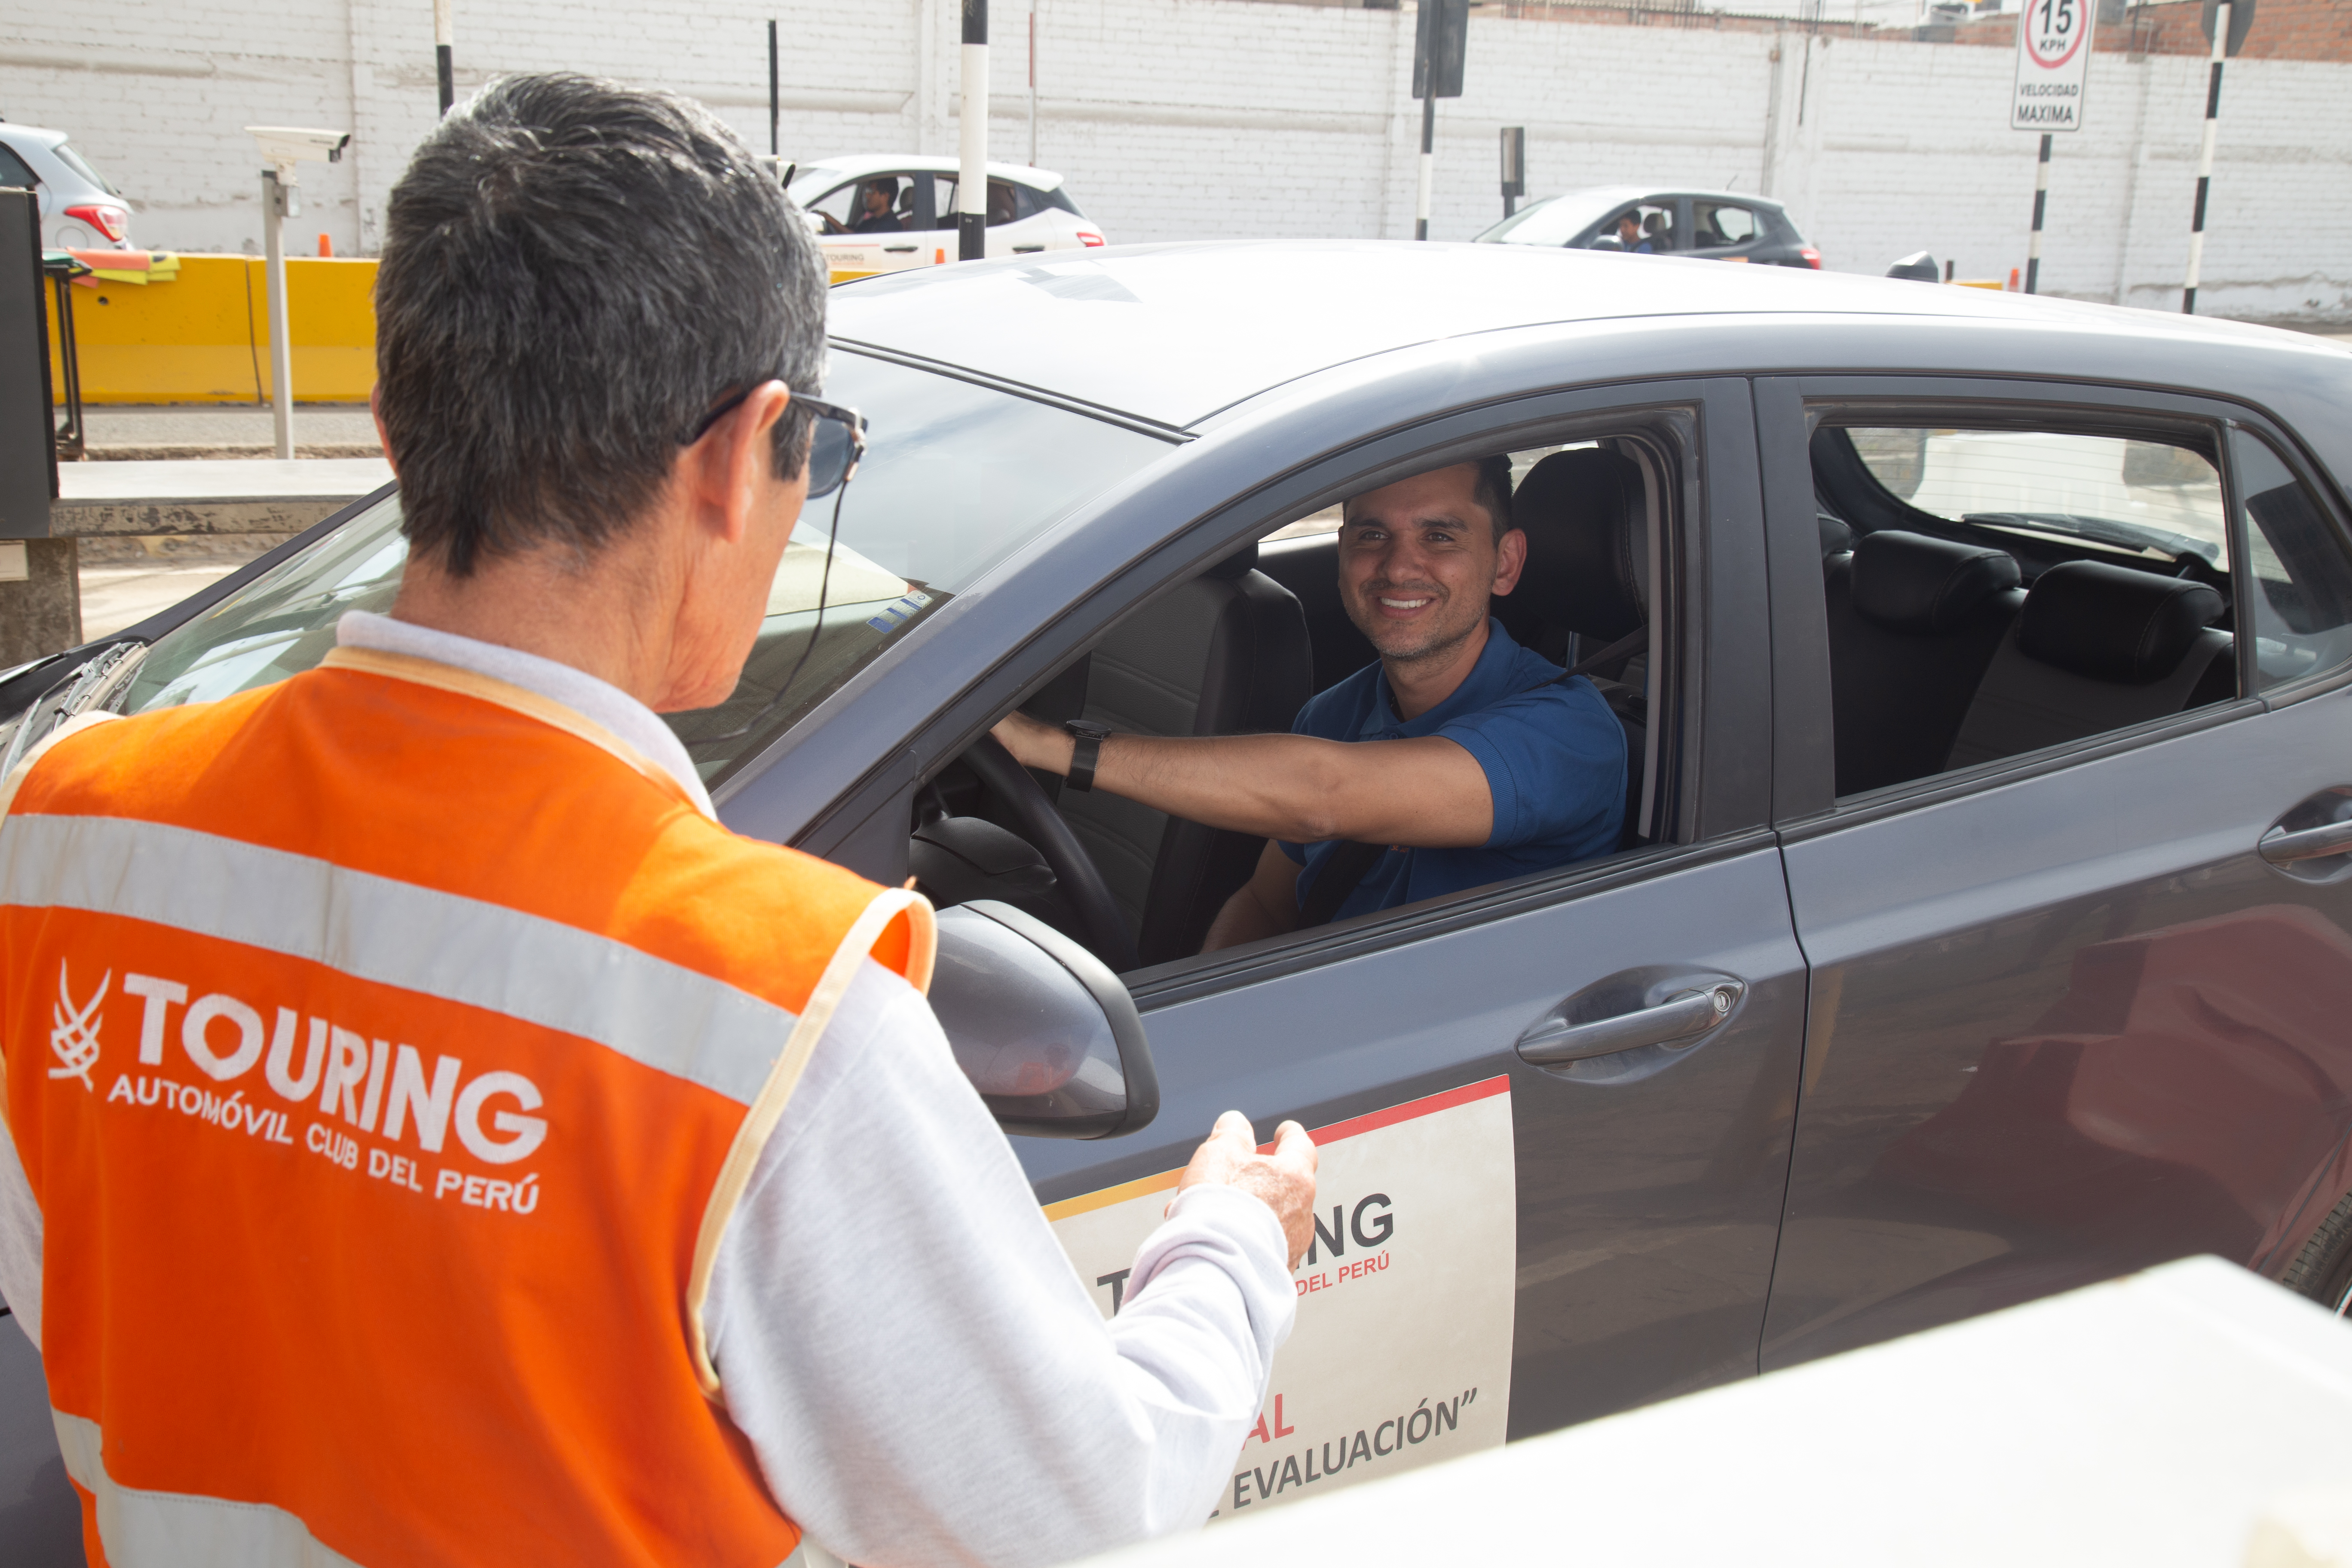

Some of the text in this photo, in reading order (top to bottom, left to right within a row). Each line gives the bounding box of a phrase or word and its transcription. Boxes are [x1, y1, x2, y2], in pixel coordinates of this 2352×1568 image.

[2040, 0, 2073, 34] 15
[2040, 39, 2066, 51] KPH
[2017, 104, 2073, 122] MAXIMA
[2020, 83, 2079, 97] VELOCIDAD
[124, 972, 548, 1164] TOURING
[107, 1074, 539, 1214] AUTOMÓVIL CLUB DEL PERÚ
[1295, 1250, 1389, 1297] DEL PERÚ
[1241, 1393, 1295, 1451] AL
[1234, 1387, 1477, 1510] EVALUACIÓN”
